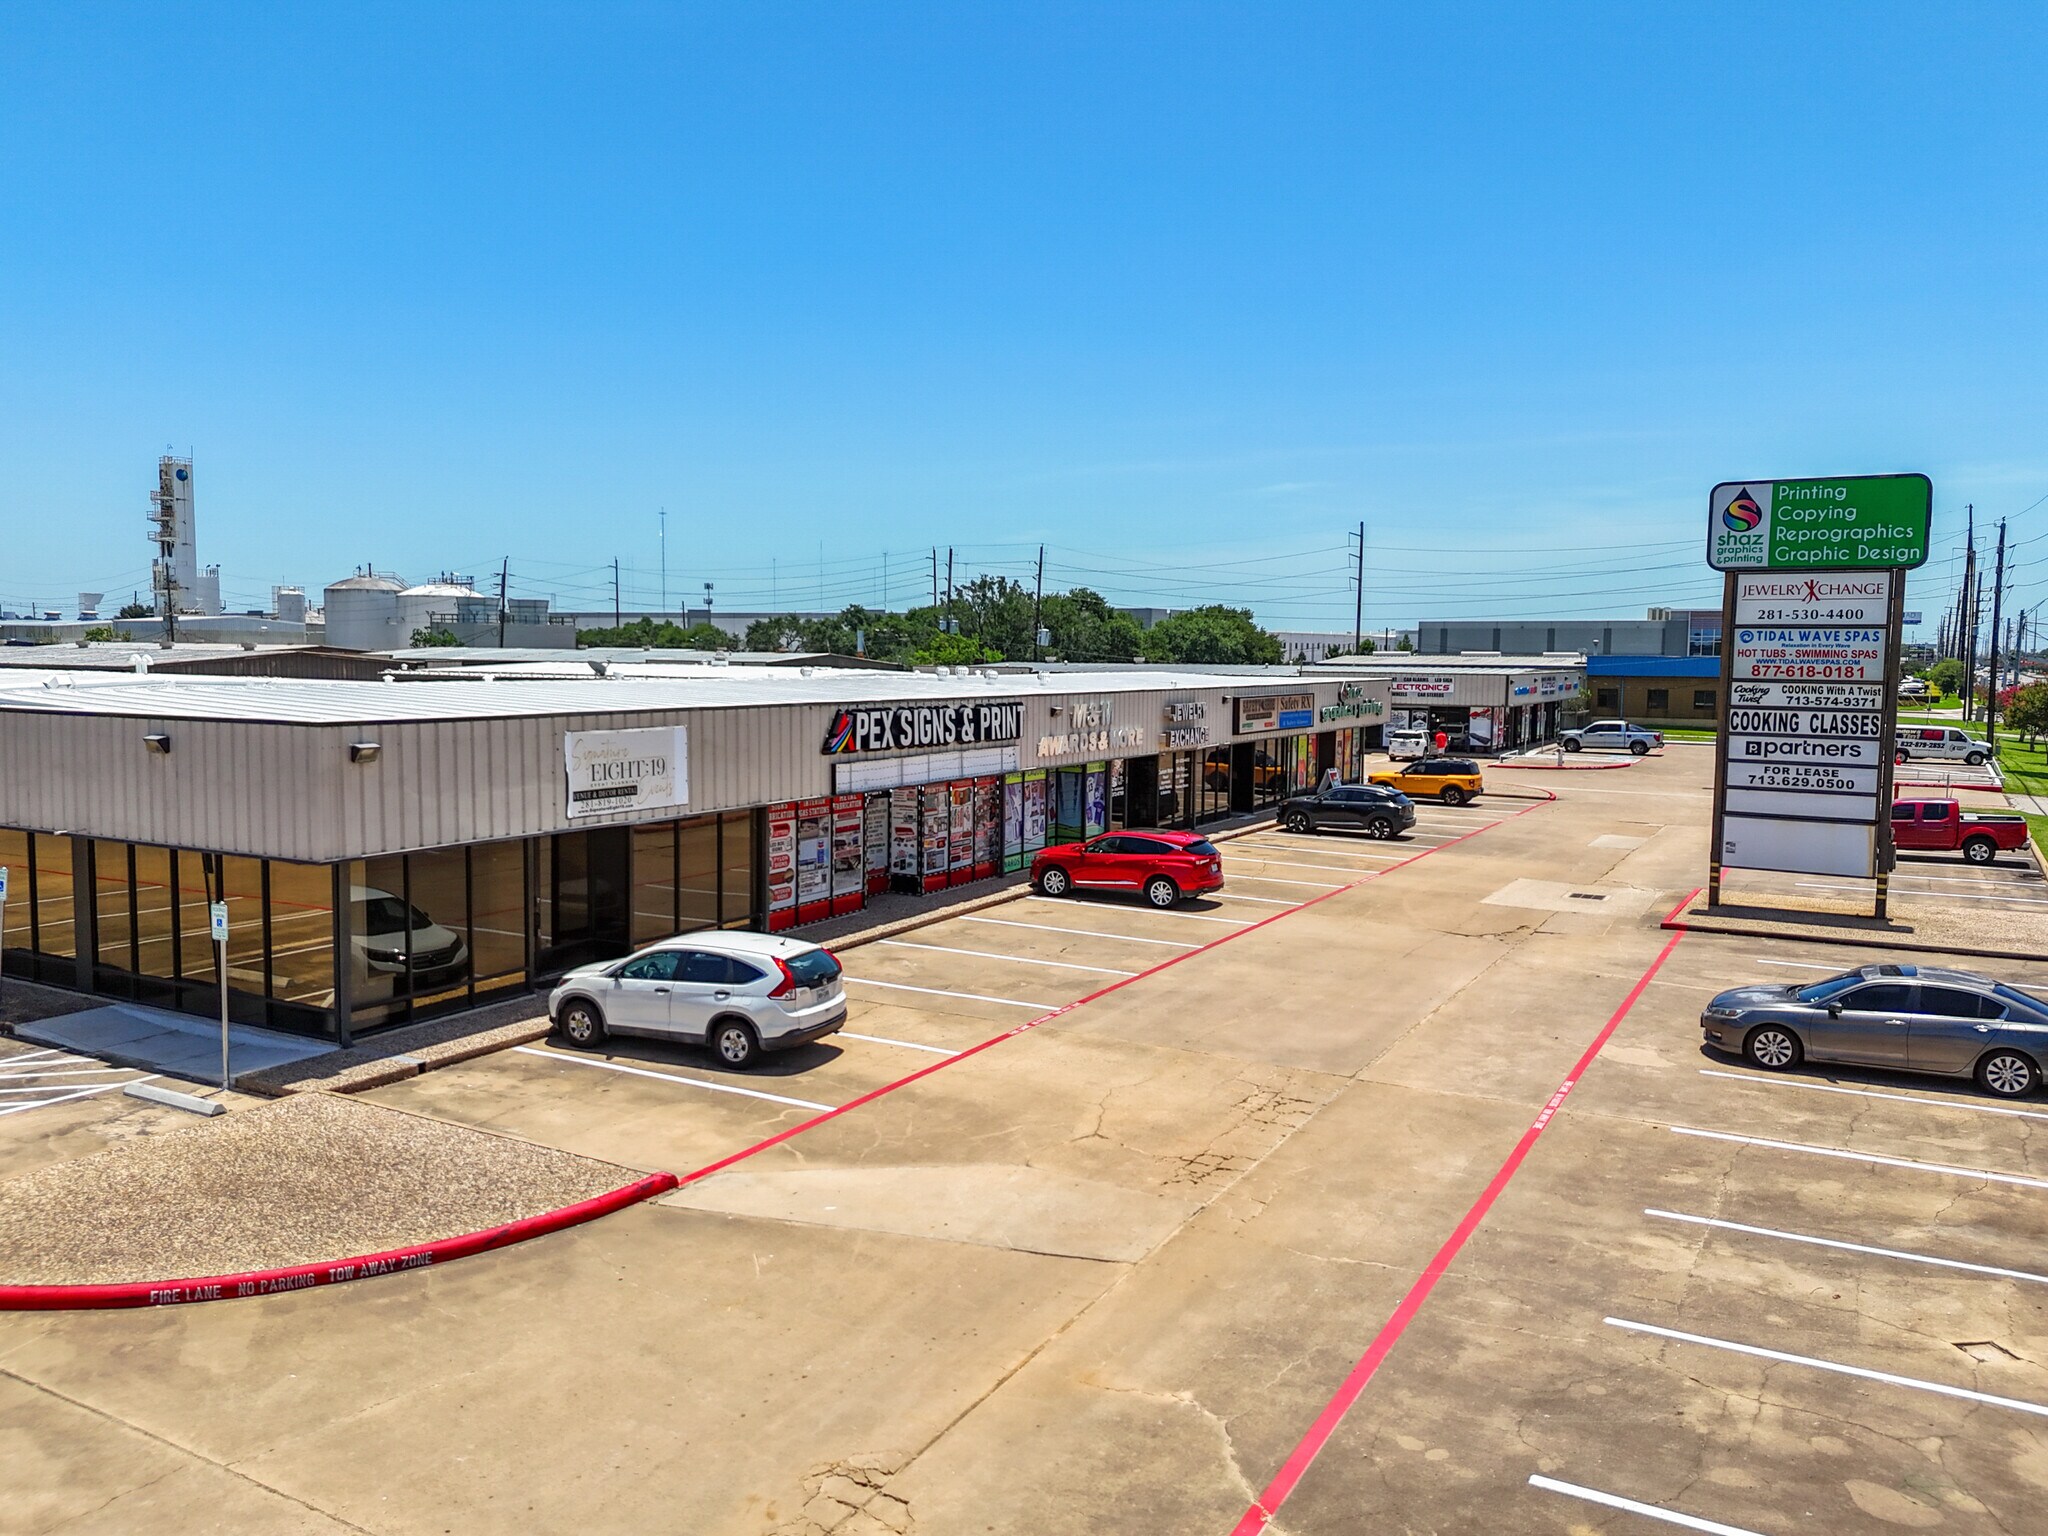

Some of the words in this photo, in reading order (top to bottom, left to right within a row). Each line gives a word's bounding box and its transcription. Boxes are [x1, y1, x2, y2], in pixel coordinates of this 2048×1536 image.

[1779, 485, 1847, 501] Printing
[1777, 505, 1857, 522] Copying
[1717, 531, 1765, 547] shaz
[1776, 524, 1914, 543] Reprographics
[1716, 545, 1764, 557] graphics
[1775, 545, 1850, 564] Graphic
[1857, 545, 1921, 562] Design
[1742, 583, 1803, 599] JEWELRY
[1758, 608, 1864, 620] 281-530-4400
[1757, 630, 1795, 642] TIDAL
[1798, 630, 1841, 642] WAVE
[1844, 630, 1880, 643] SPAS
[1817, 642, 1834, 650] Every
[1737, 649, 1758, 659] HOT
[1760, 649, 1786, 659] TUBS
[1795, 649, 1849, 660] SWIMMING
[1851, 649, 1878, 660] SPAS
[1755, 658, 1861, 666] WWW.TIDALWAVESPAS.COM
[1751, 665, 1866, 679] 877-618-0181
[1392, 683, 1450, 692] LECTRONICS
[1734, 684, 1771, 697] Cooking
[1781, 685, 1824, 695] COOKING
[1826, 685, 1847, 696] With
[1848, 687, 1856, 696] A
[1857, 686, 1882, 697] Twist
[1280, 696, 1299, 711] Safety
[1301, 695, 1311, 709] RX
[1738, 694, 1764, 705] Twist
[1786, 695, 1877, 708] 713-574-9371
[1172, 702, 1207, 722] JEWELRY
[900, 707, 956, 747] SIGNS
[961, 707, 975, 742] &
[981, 704, 1025, 741] PRINT
[1730, 711, 1800, 733] COOKING
[1809, 713, 1880, 736] CLASSES
[1038, 731, 1098, 757] AWARDS
[1110, 728, 1144, 749] MORE
[1170, 726, 1209, 748] EXCHANGE
[1764, 740, 1862, 758] partners
[591, 757, 666, 782] EIGHT:19
[1764, 766, 1791, 776] FOR
[1796, 768, 1840, 777] LEASE
[1748, 775, 1855, 790] 713.629.0500
[573, 791, 592, 801] VENUE
[598, 789, 617, 798] DECOR
[581, 796, 632, 810] 281-819-1020
[799, 809, 809, 817] GAS
[809, 806, 830, 816] STATIONS
[149, 1288, 180, 1303] FIRE
[186, 1285, 222, 1303] LANE
[238, 1280, 255, 1296] NO
[260, 1273, 315, 1293] PARKING
[329, 1265, 355, 1282] TOW
[359, 1258, 398, 1278] AWAY
[401, 1251, 432, 1269] ZONE
